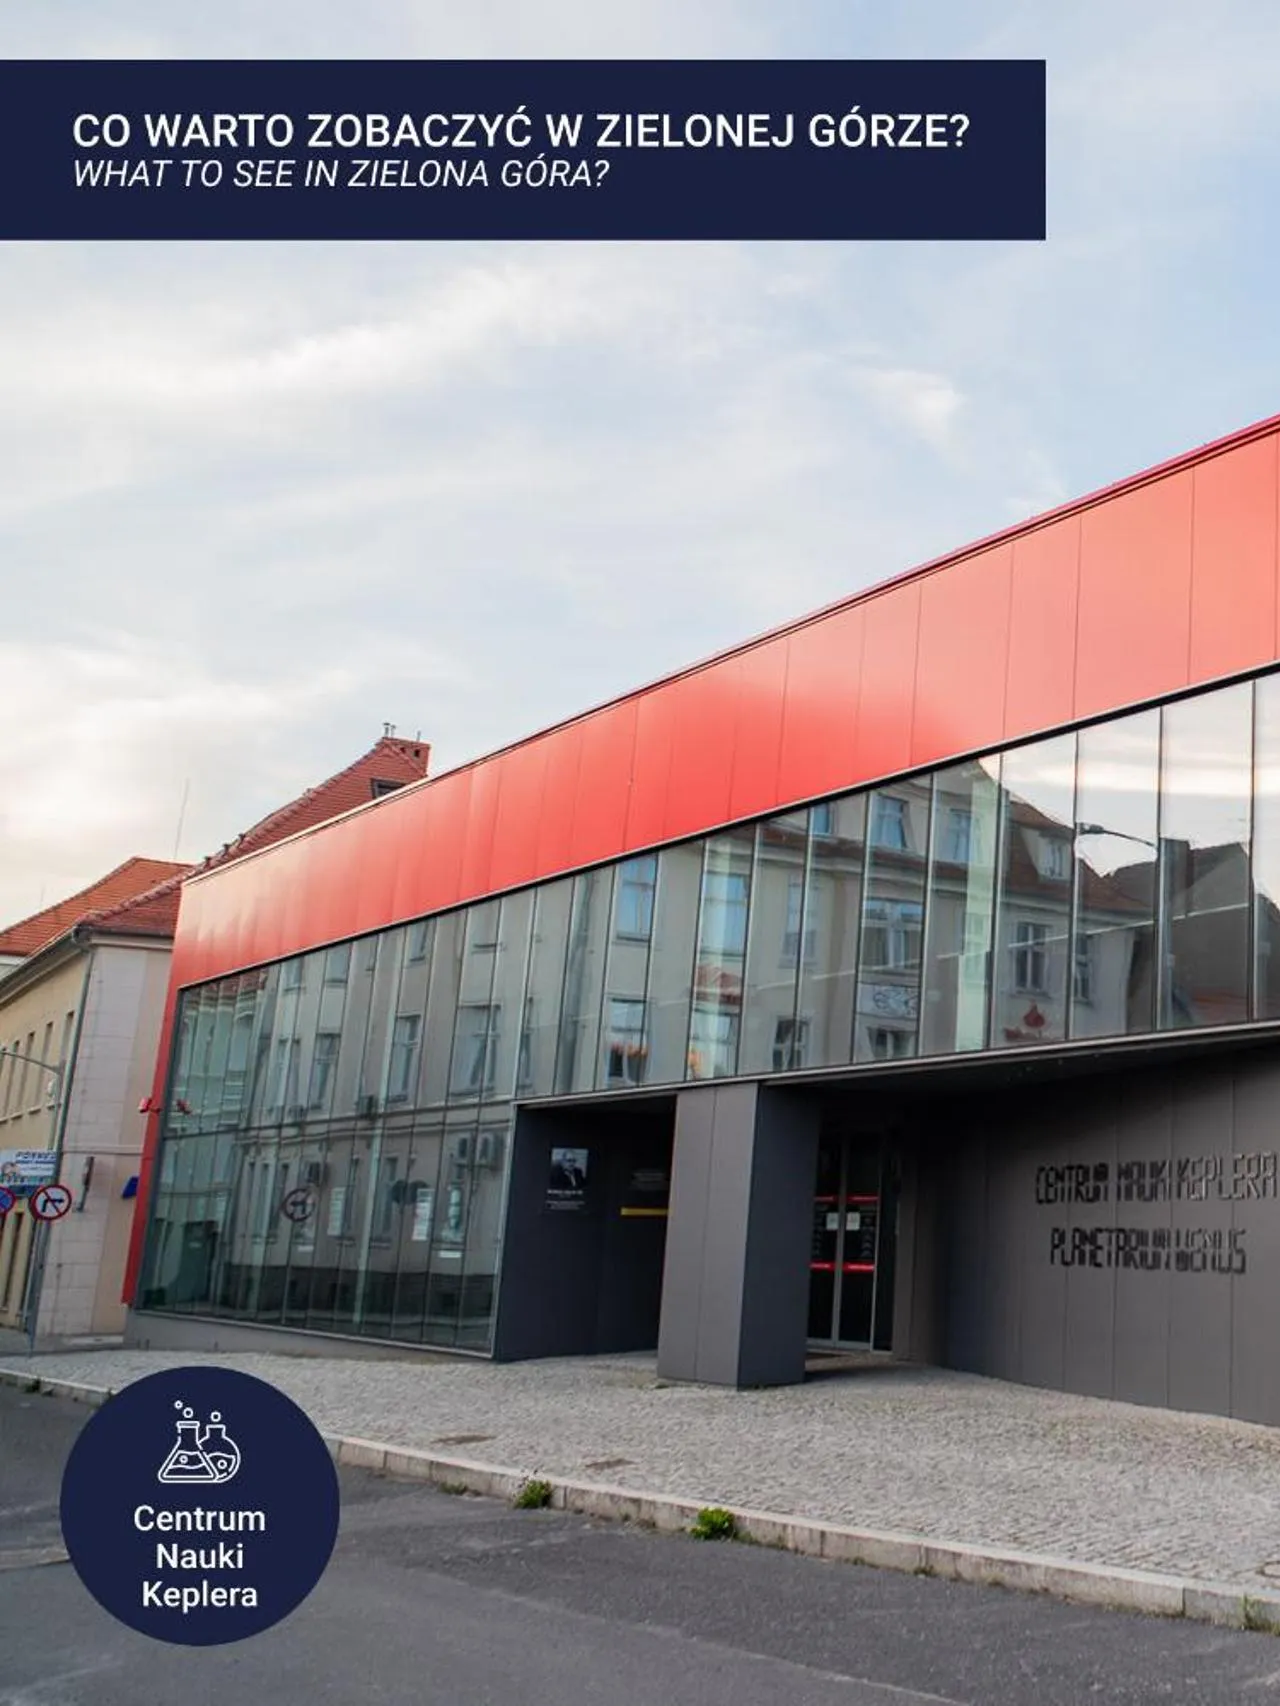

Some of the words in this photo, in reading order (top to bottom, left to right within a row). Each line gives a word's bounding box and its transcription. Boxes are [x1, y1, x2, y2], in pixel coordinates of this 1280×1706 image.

[1035, 1162, 1109, 1204] CENTRUM
[1116, 1158, 1173, 1202] NAUKI
[1176, 1151, 1278, 1201] KEPLERA
[1050, 1227, 1172, 1271] PLANETARIUM
[1175, 1228, 1247, 1274] WENUS
